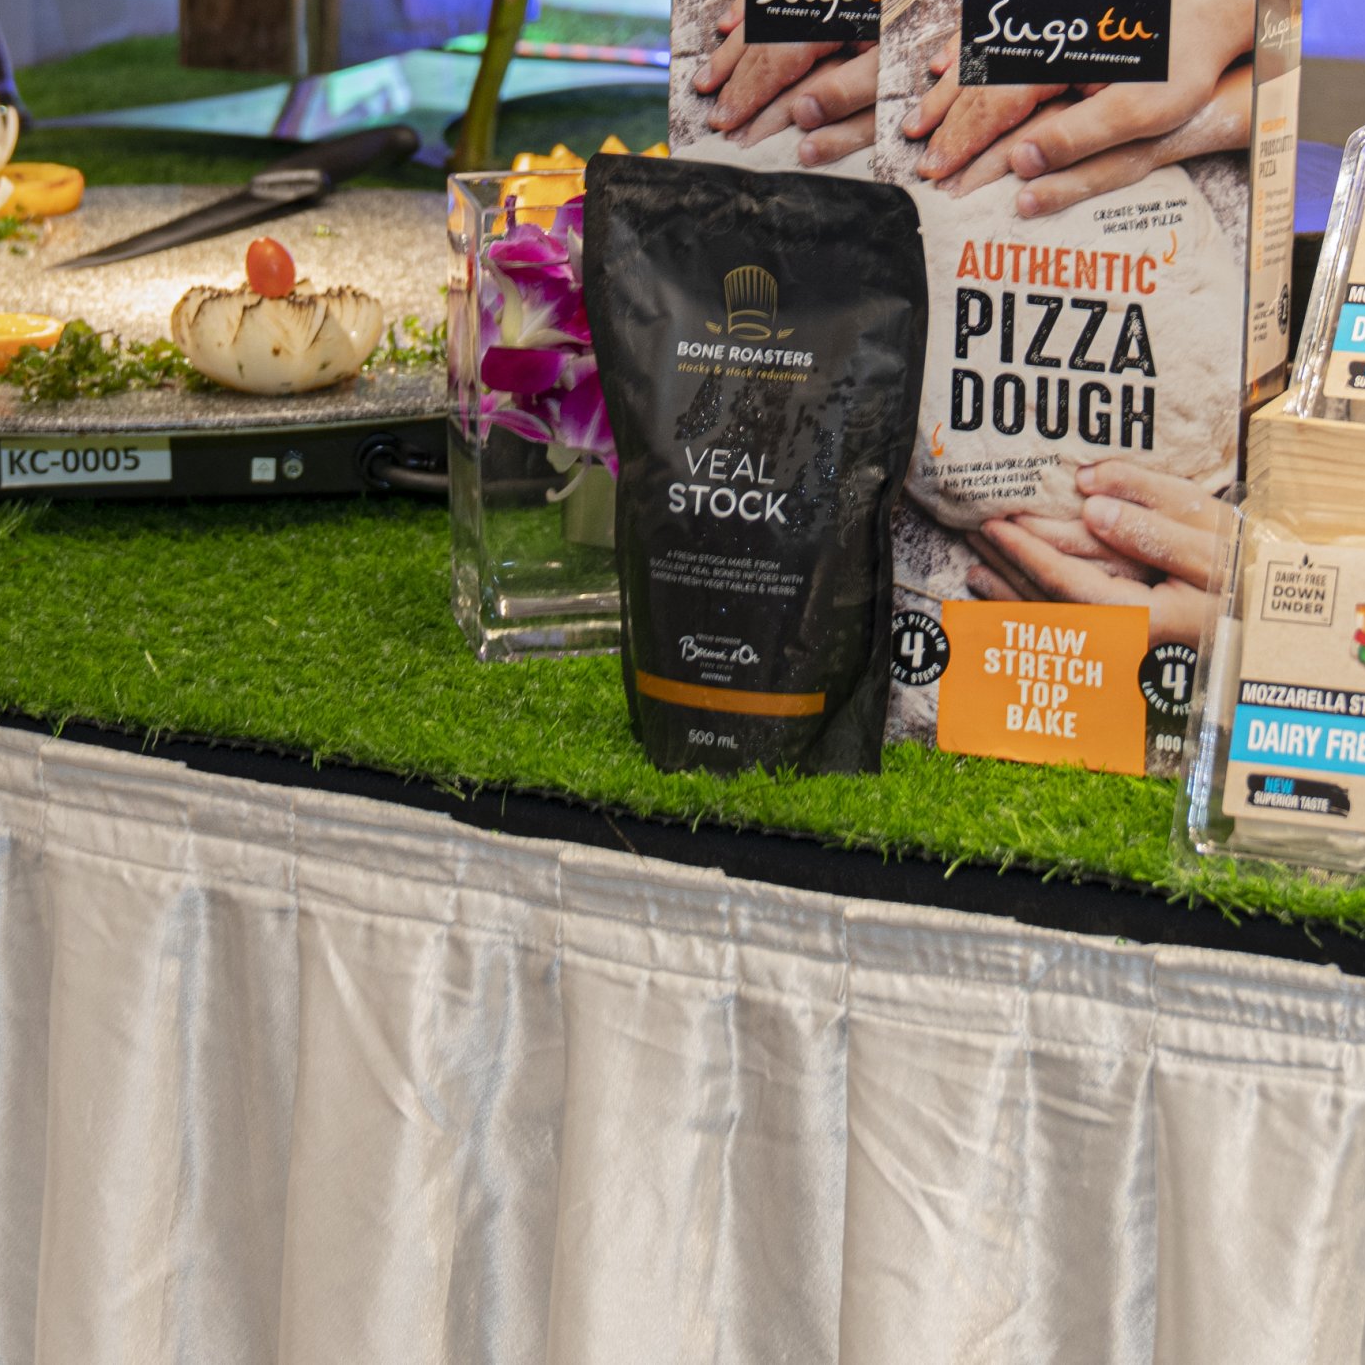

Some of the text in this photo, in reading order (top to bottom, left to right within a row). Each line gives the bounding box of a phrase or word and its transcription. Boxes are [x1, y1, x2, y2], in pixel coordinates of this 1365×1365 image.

[1097, 6, 1153, 41] tu
[955, 240, 1157, 295] AUTHENTIC
[954, 287, 1157, 377] PIZZA
[677, 341, 813, 367] BONE ROASTERS
[677, 362, 808, 382] stocks & stock reductions
[951, 368, 1155, 450] DOUGH
[8, 446, 141, 475] KC-0005
[685, 446, 775, 485] VEAL
[668, 482, 788, 524] STOCK
[1271, 599, 1323, 614] UNDER
[1273, 585, 1326, 601] DOWN
[901, 631, 926, 668] 4
[1002, 620, 1087, 657] THAW
[984, 647, 1103, 688] STRETCH
[1161, 662, 1187, 700] 4
[1016, 679, 1068, 710] TOP
[1242, 683, 1345, 714] MOZZARELLA
[688, 728, 715, 746] 500
[1005, 704, 1077, 739] BAKE
[1247, 719, 1323, 757] DAIRY
[1254, 790, 1330, 813] SUPERIOR TASTE
[1264, 776, 1295, 795] NEW
